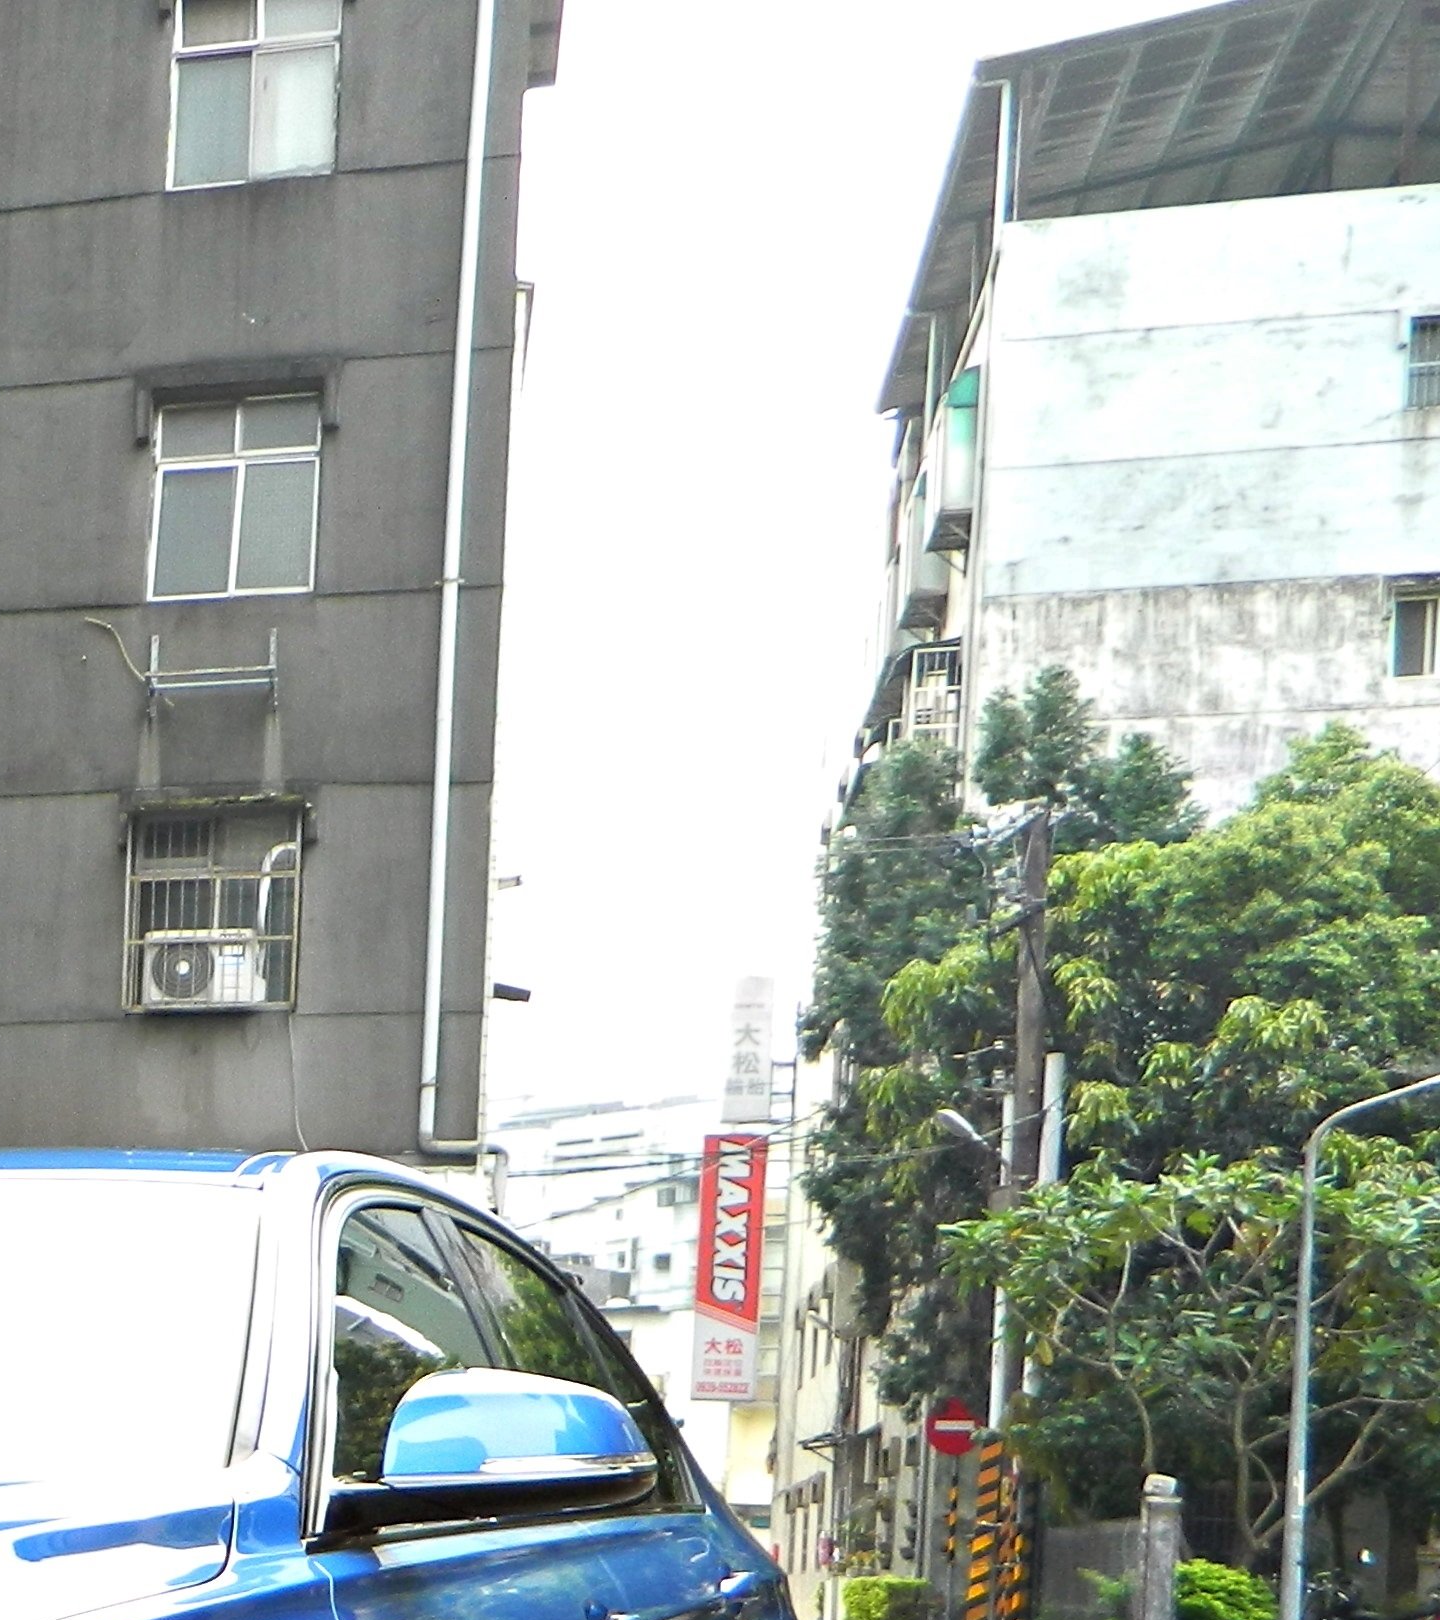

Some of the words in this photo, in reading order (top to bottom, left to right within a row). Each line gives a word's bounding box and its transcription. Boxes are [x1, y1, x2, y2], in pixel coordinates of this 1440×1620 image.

[733, 1022, 761, 1075] 大松
[710, 1138, 753, 1303] MAXXIS
[704, 1337, 744, 1354] 大松
